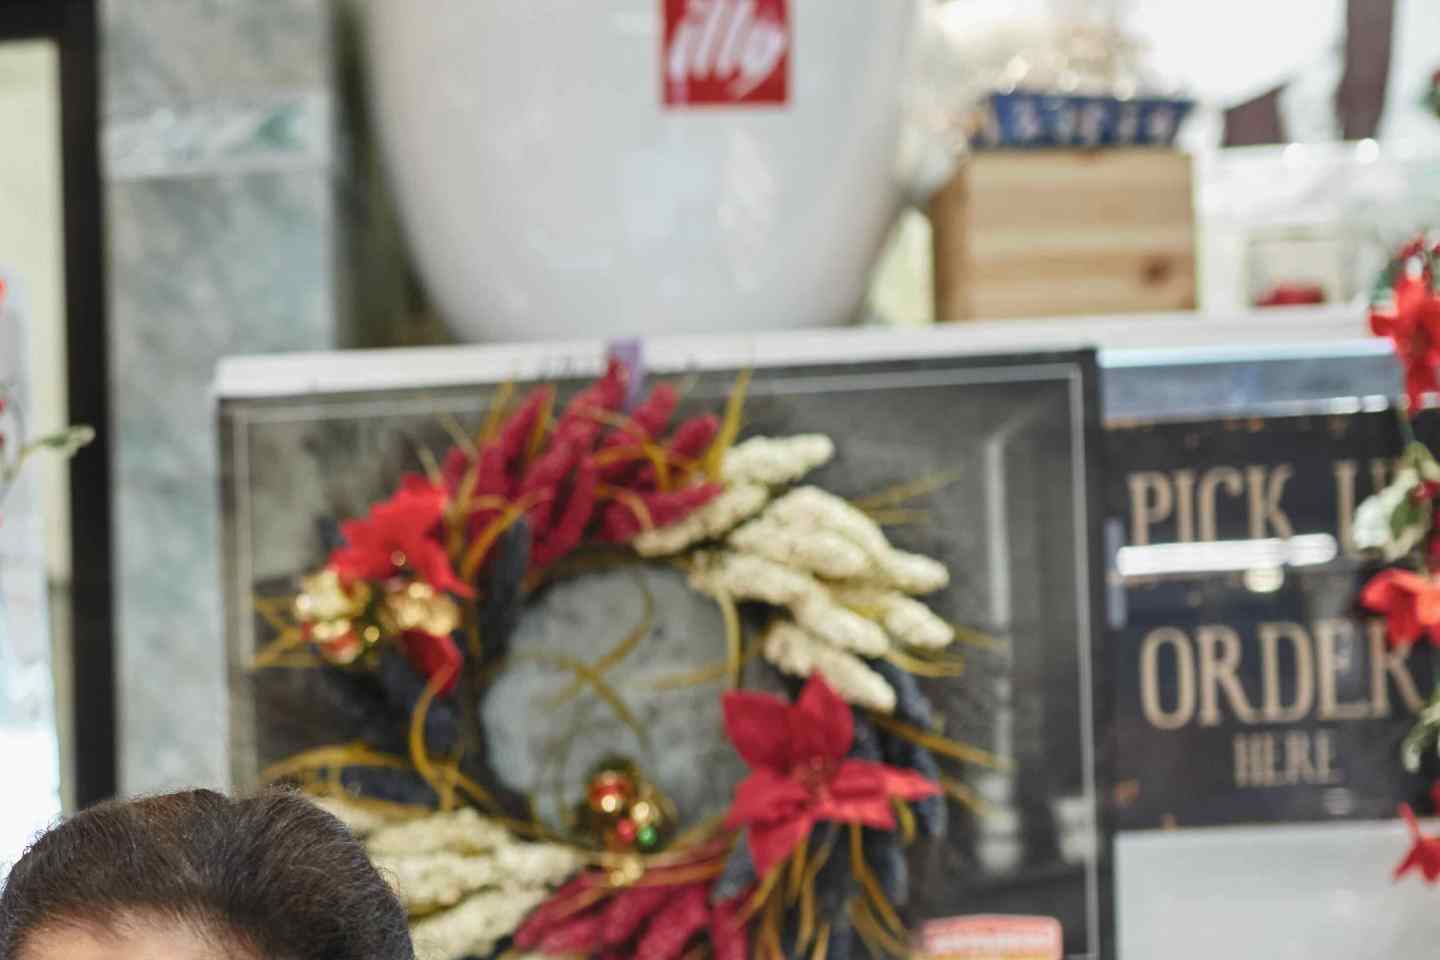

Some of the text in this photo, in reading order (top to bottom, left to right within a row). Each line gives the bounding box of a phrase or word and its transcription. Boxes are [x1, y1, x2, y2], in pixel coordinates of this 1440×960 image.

[669, 0, 782, 98] illy
[1126, 466, 1294, 546] PICK
[1138, 618, 1426, 730] ORDER
[1233, 733, 1336, 788] HERE
